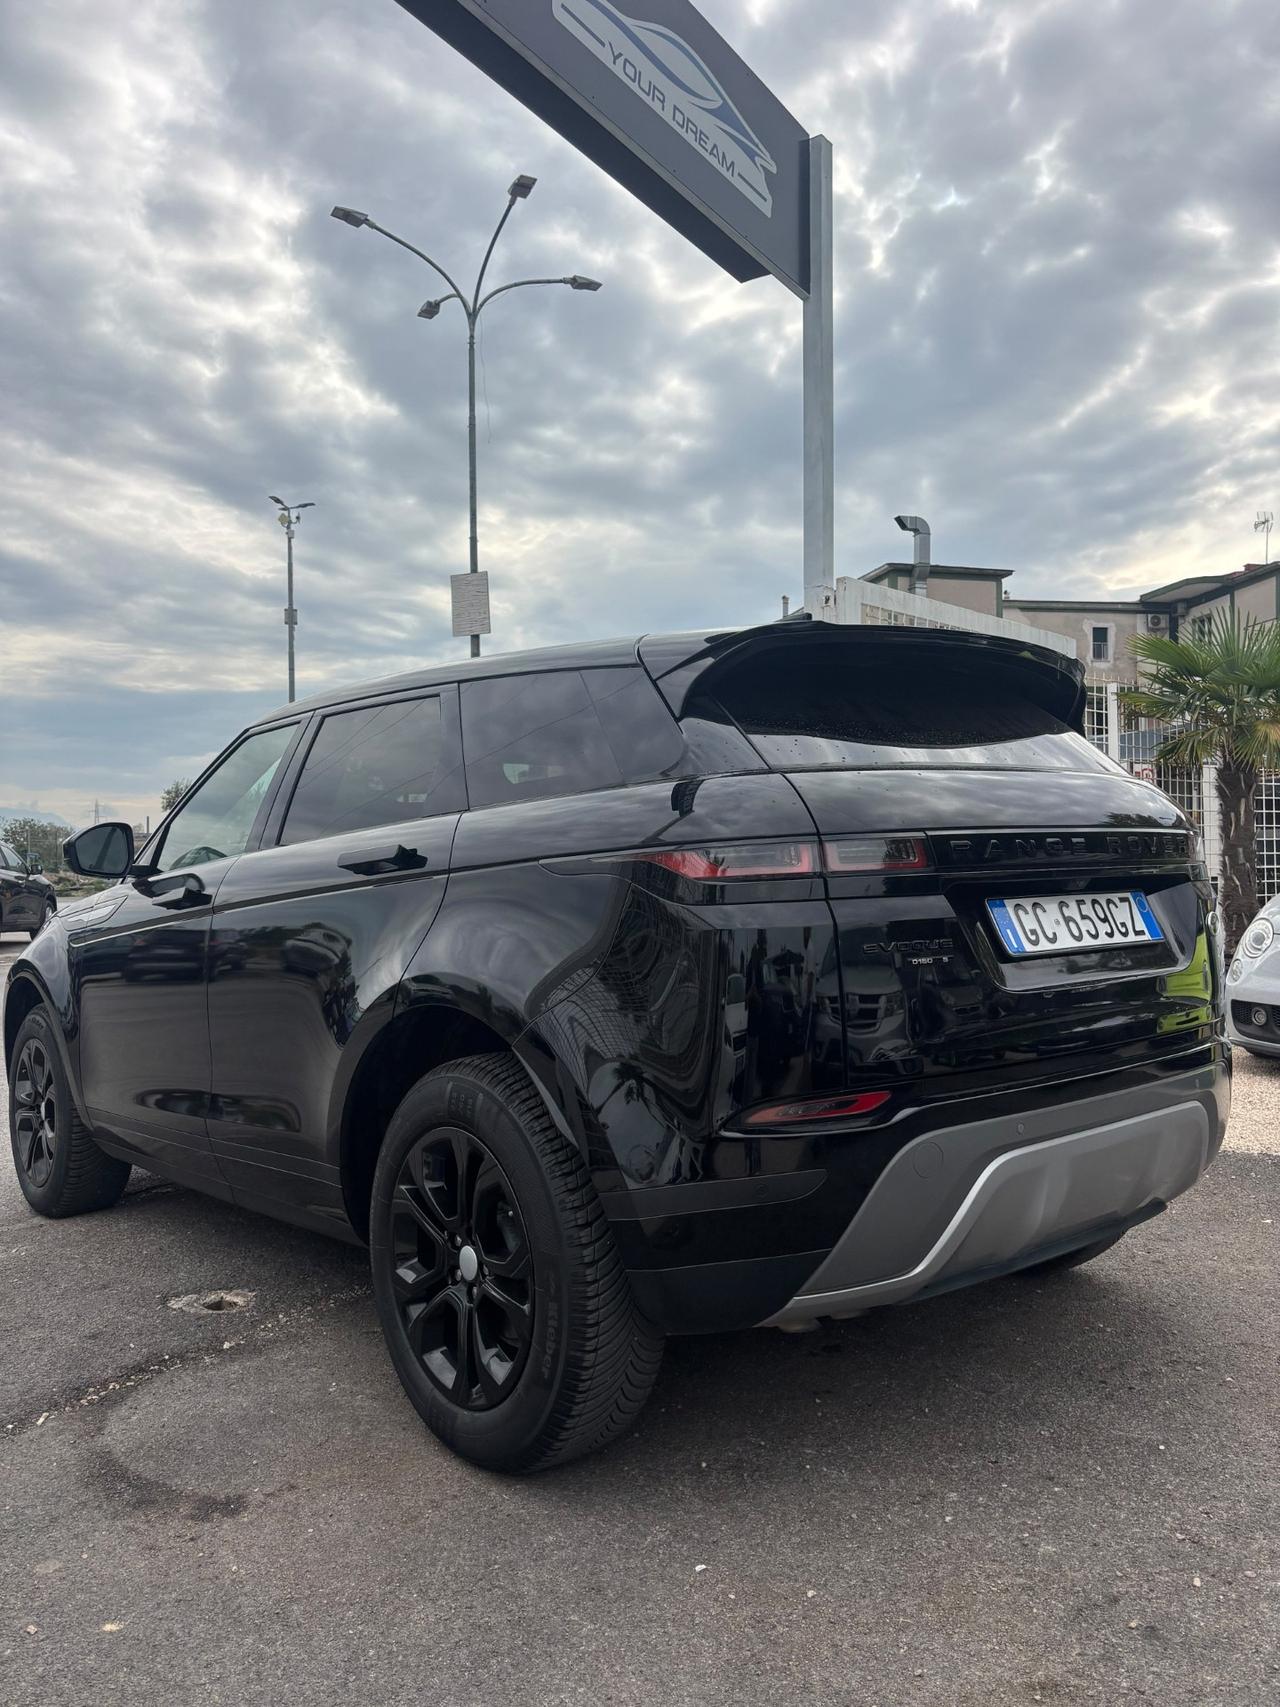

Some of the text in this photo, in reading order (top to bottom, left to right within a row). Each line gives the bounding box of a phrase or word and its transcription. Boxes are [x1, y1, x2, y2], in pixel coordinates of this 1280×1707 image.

[607, 40, 736, 178] YOUR DREAM
[949, 835, 1188, 859] RANGE ROVER
[862, 938, 954, 955] EVOQUE
